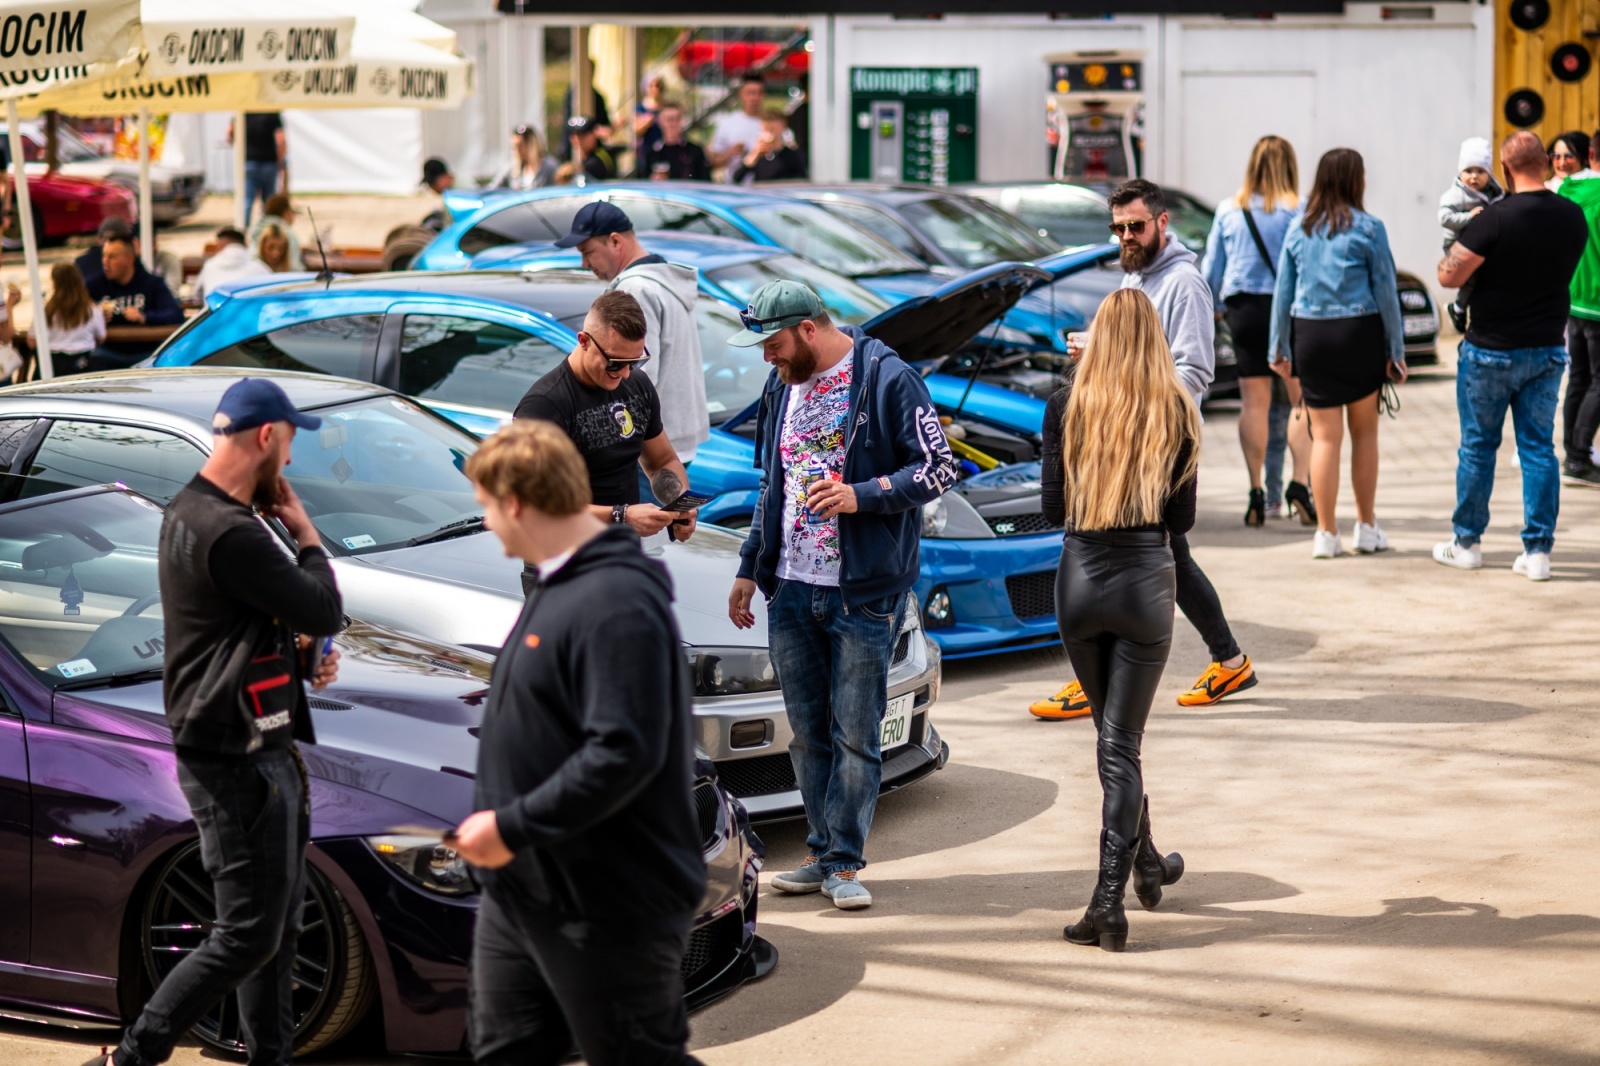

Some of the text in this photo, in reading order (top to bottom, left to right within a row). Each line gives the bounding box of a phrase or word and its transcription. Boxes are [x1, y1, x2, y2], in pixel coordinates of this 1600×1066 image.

[0, 9, 87, 58] OCIM
[188, 27, 245, 65] OKOCIM
[880, 715, 905, 747] ERO
